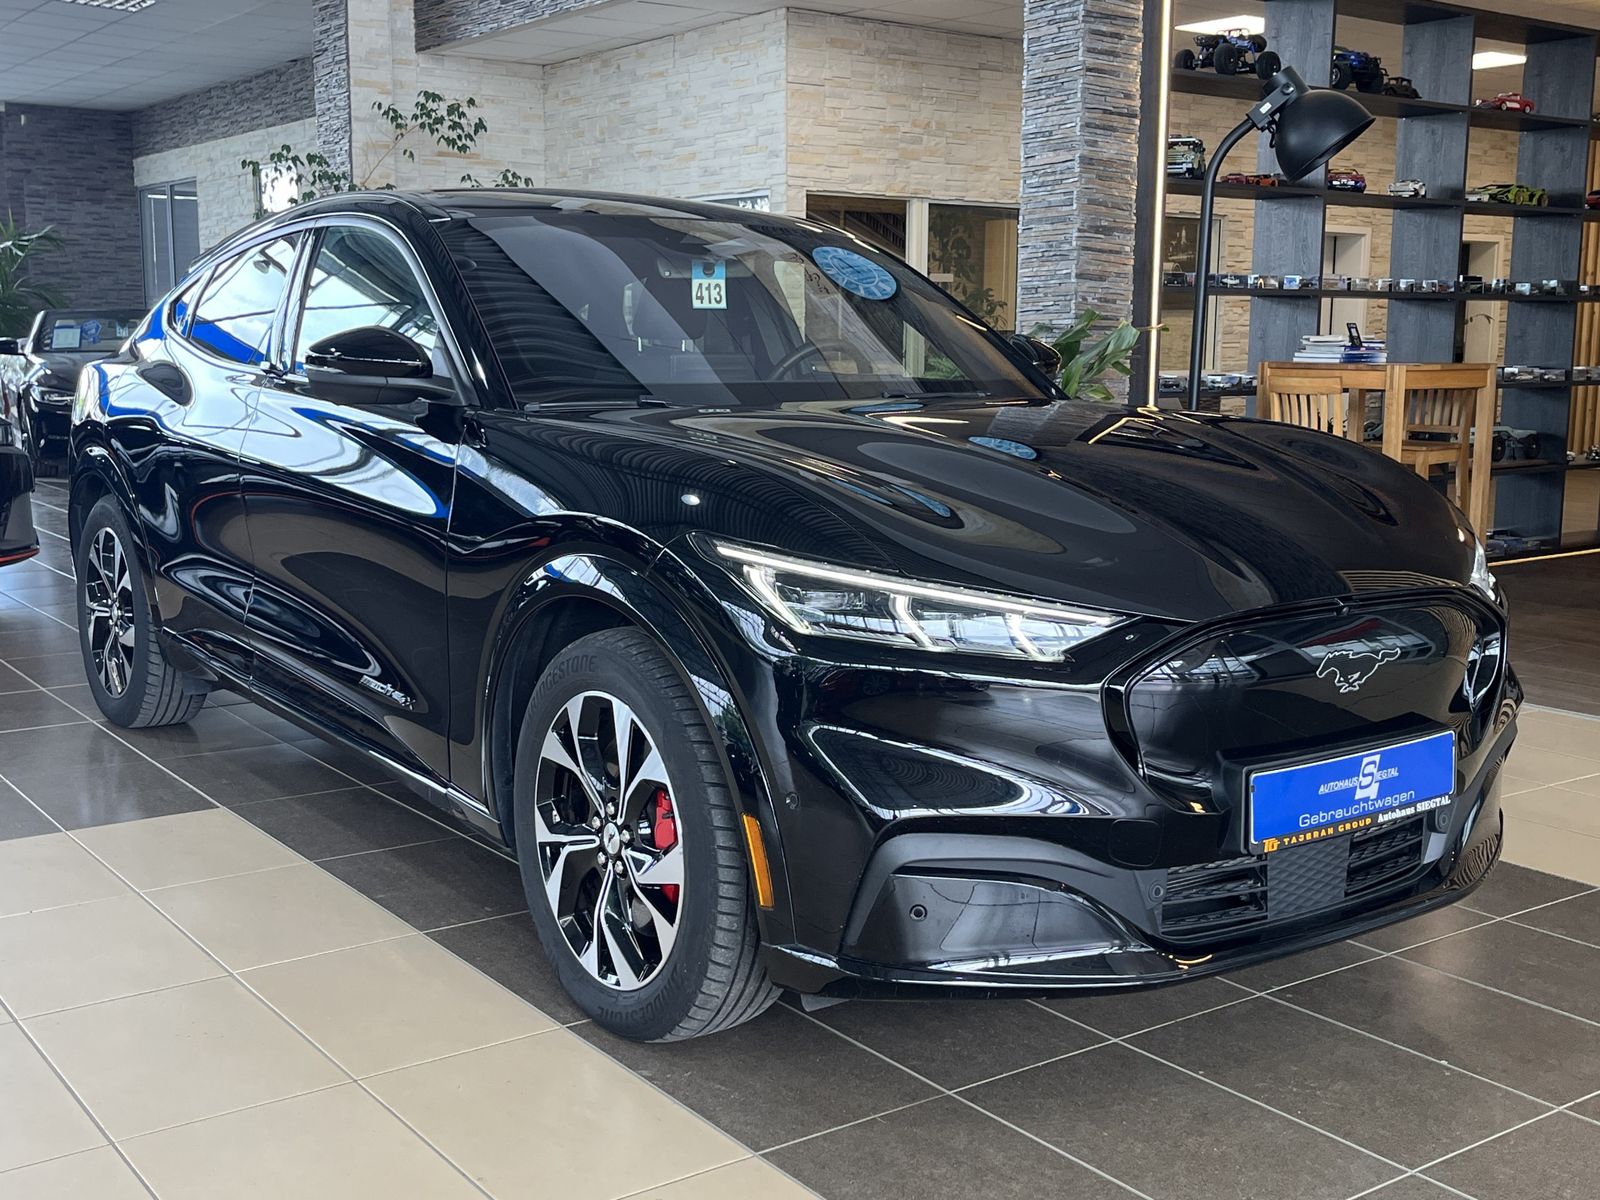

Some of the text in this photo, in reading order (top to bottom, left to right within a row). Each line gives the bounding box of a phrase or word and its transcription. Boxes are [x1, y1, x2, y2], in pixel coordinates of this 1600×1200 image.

[696, 283, 722, 304] 413
[1318, 775, 1360, 795] AUTOHAUS
[1299, 790, 1415, 828] Gebrauchtwagen
[1377, 795, 1452, 823] Autohaus SIEGTAL
[1338, 817, 1372, 832] GROUP
